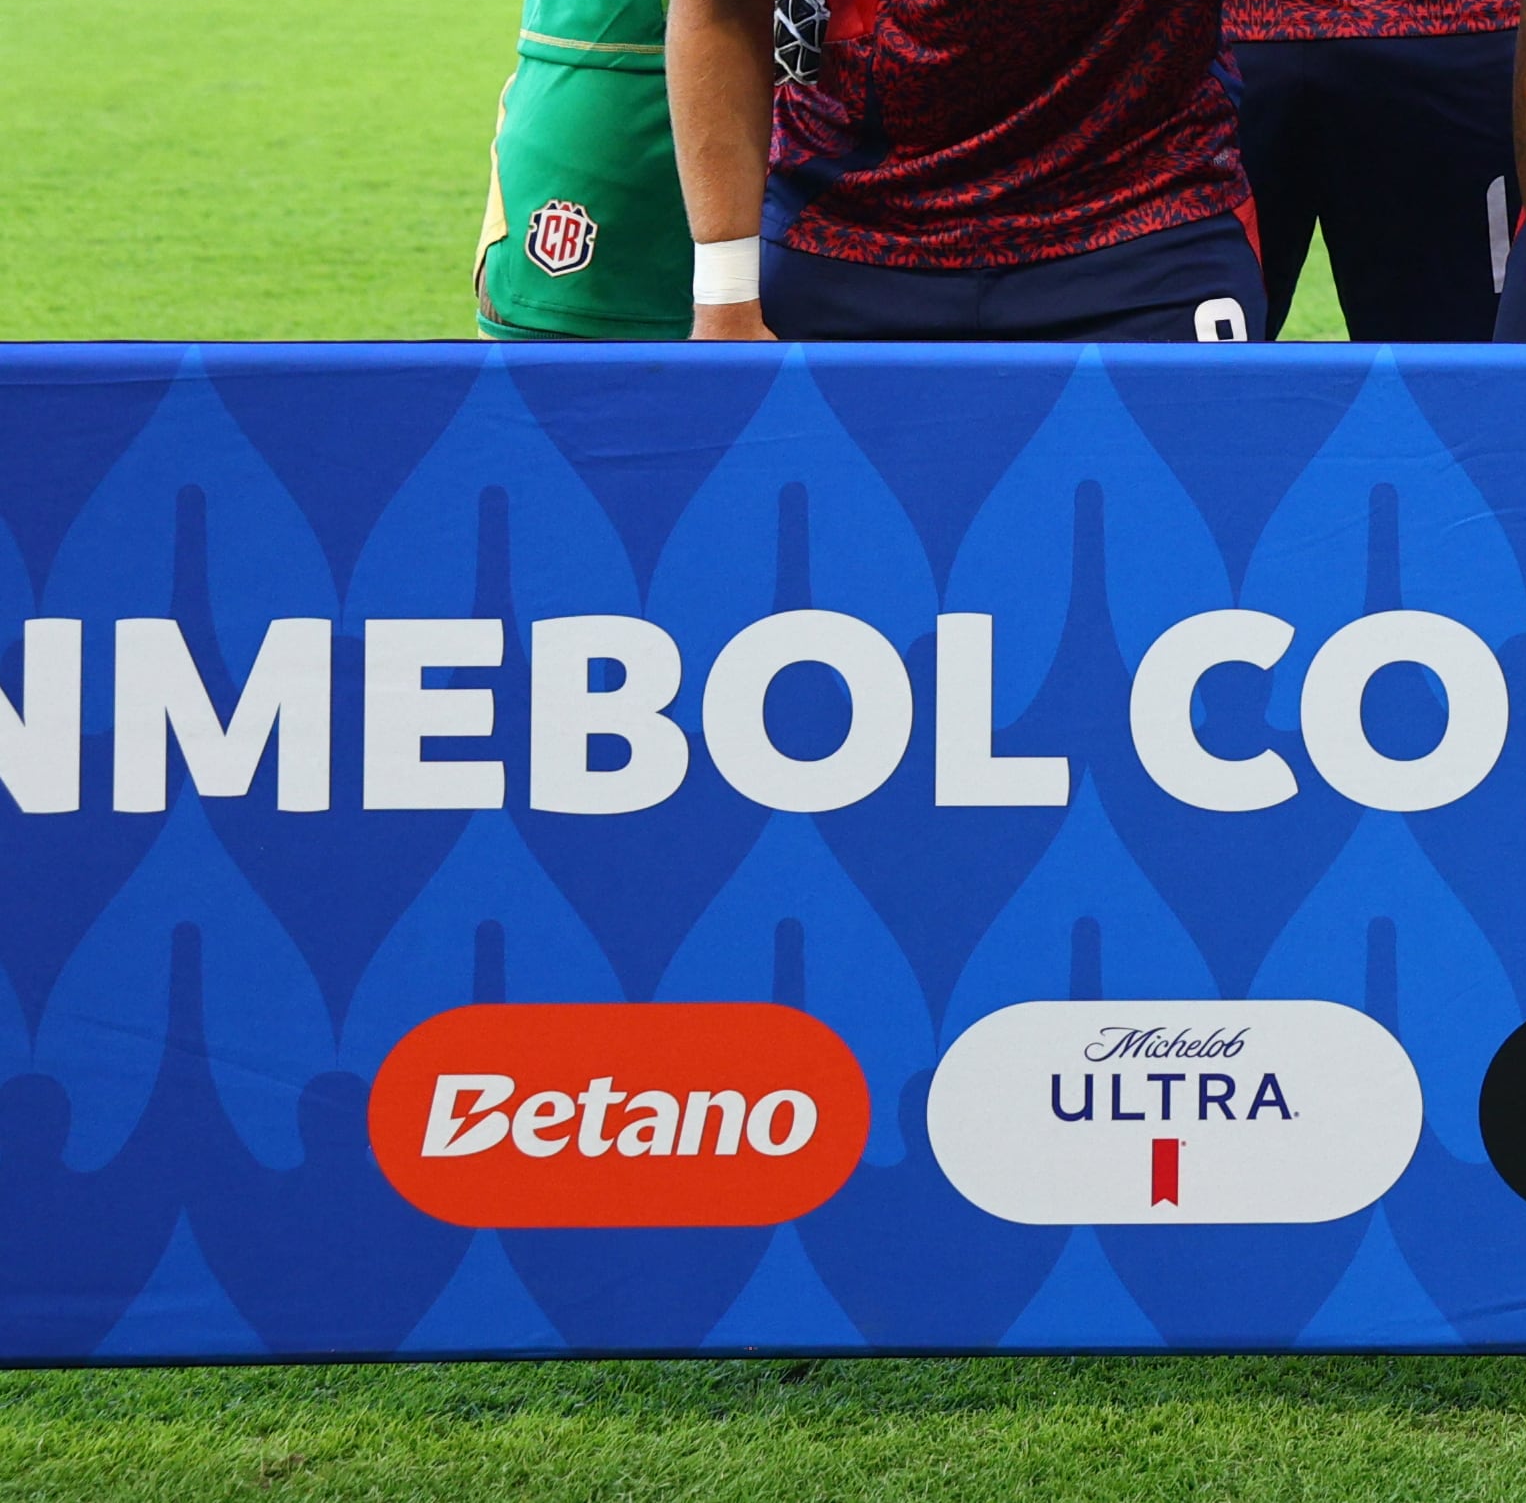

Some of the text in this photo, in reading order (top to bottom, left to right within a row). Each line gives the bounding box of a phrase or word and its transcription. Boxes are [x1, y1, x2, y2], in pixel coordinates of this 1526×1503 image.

[540, 214, 582, 263] CR
[1084, 1027, 1251, 1062] Michelob
[420, 1072, 818, 1158] Betano
[1051, 1072, 1293, 1122] ULTRA
